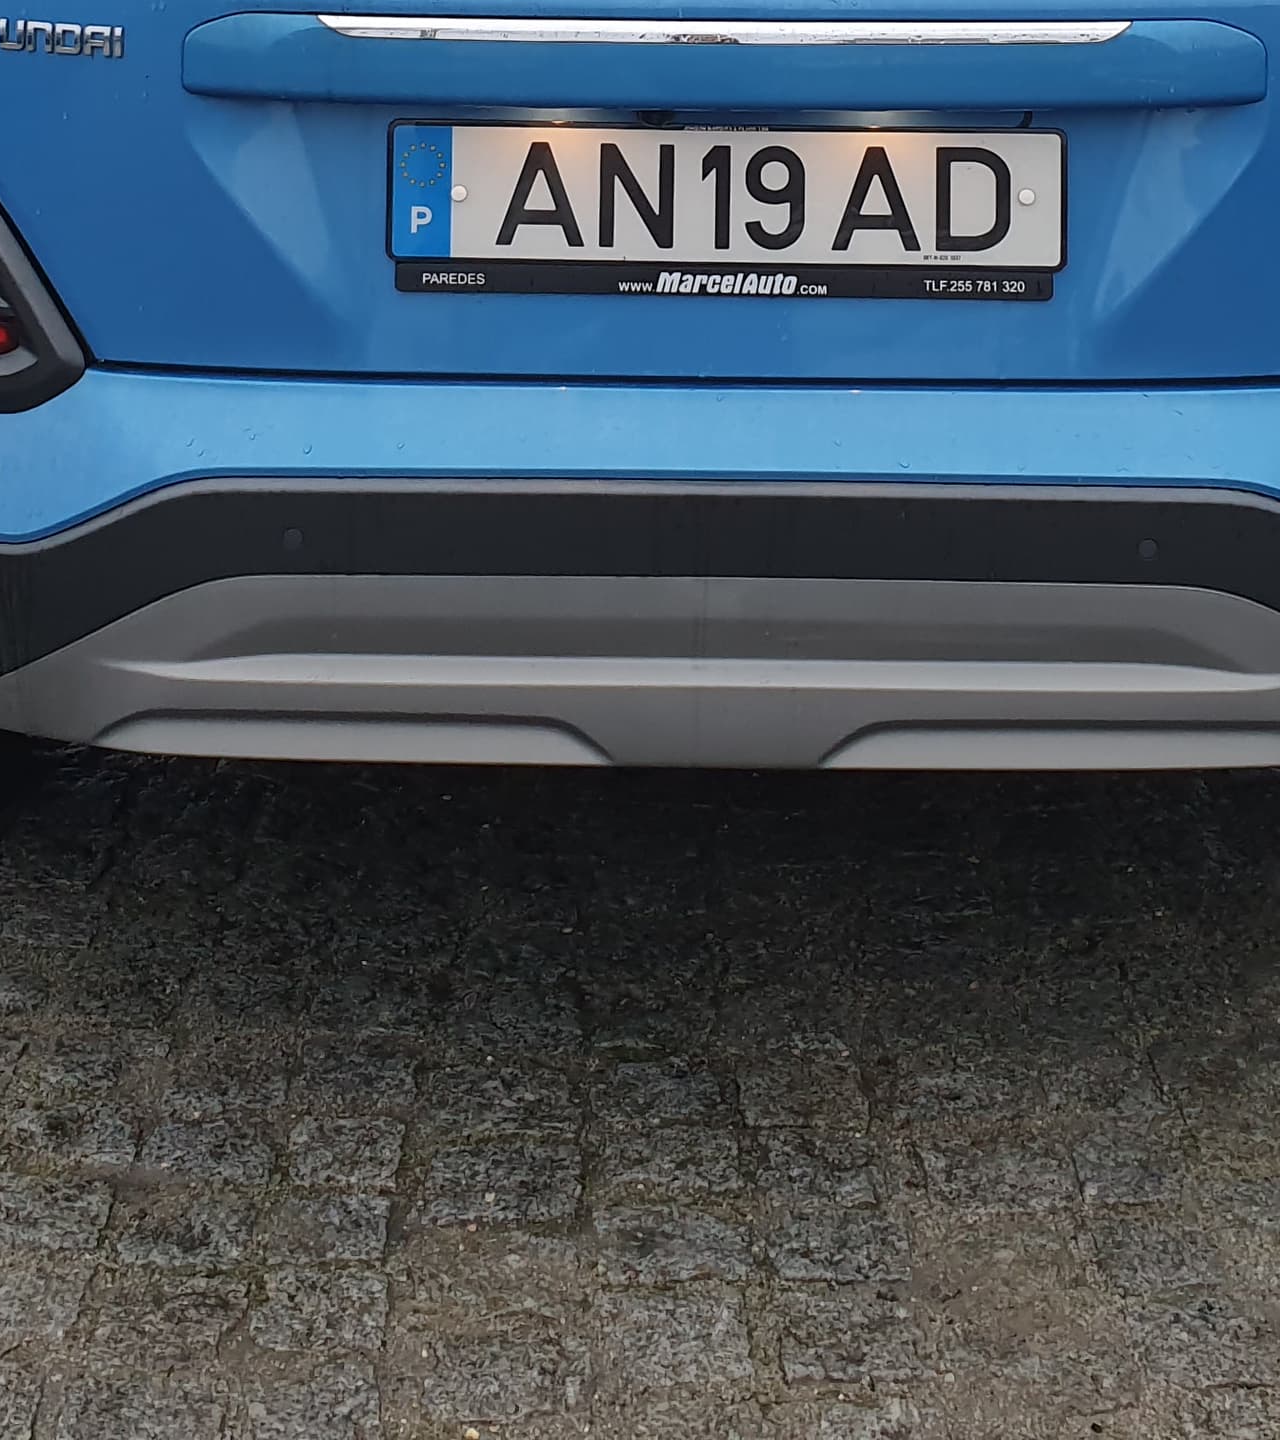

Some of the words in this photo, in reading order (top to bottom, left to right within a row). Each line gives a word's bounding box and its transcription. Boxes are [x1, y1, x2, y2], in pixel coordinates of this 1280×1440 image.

[495, 141, 675, 249] AN
[701, 144, 806, 251] 19
[831, 146, 1012, 252] AD
[410, 205, 433, 234] P
[422, 272, 486, 285] PAREDES
[977, 280, 997, 292] 781
[1002, 280, 1025, 293] 320
